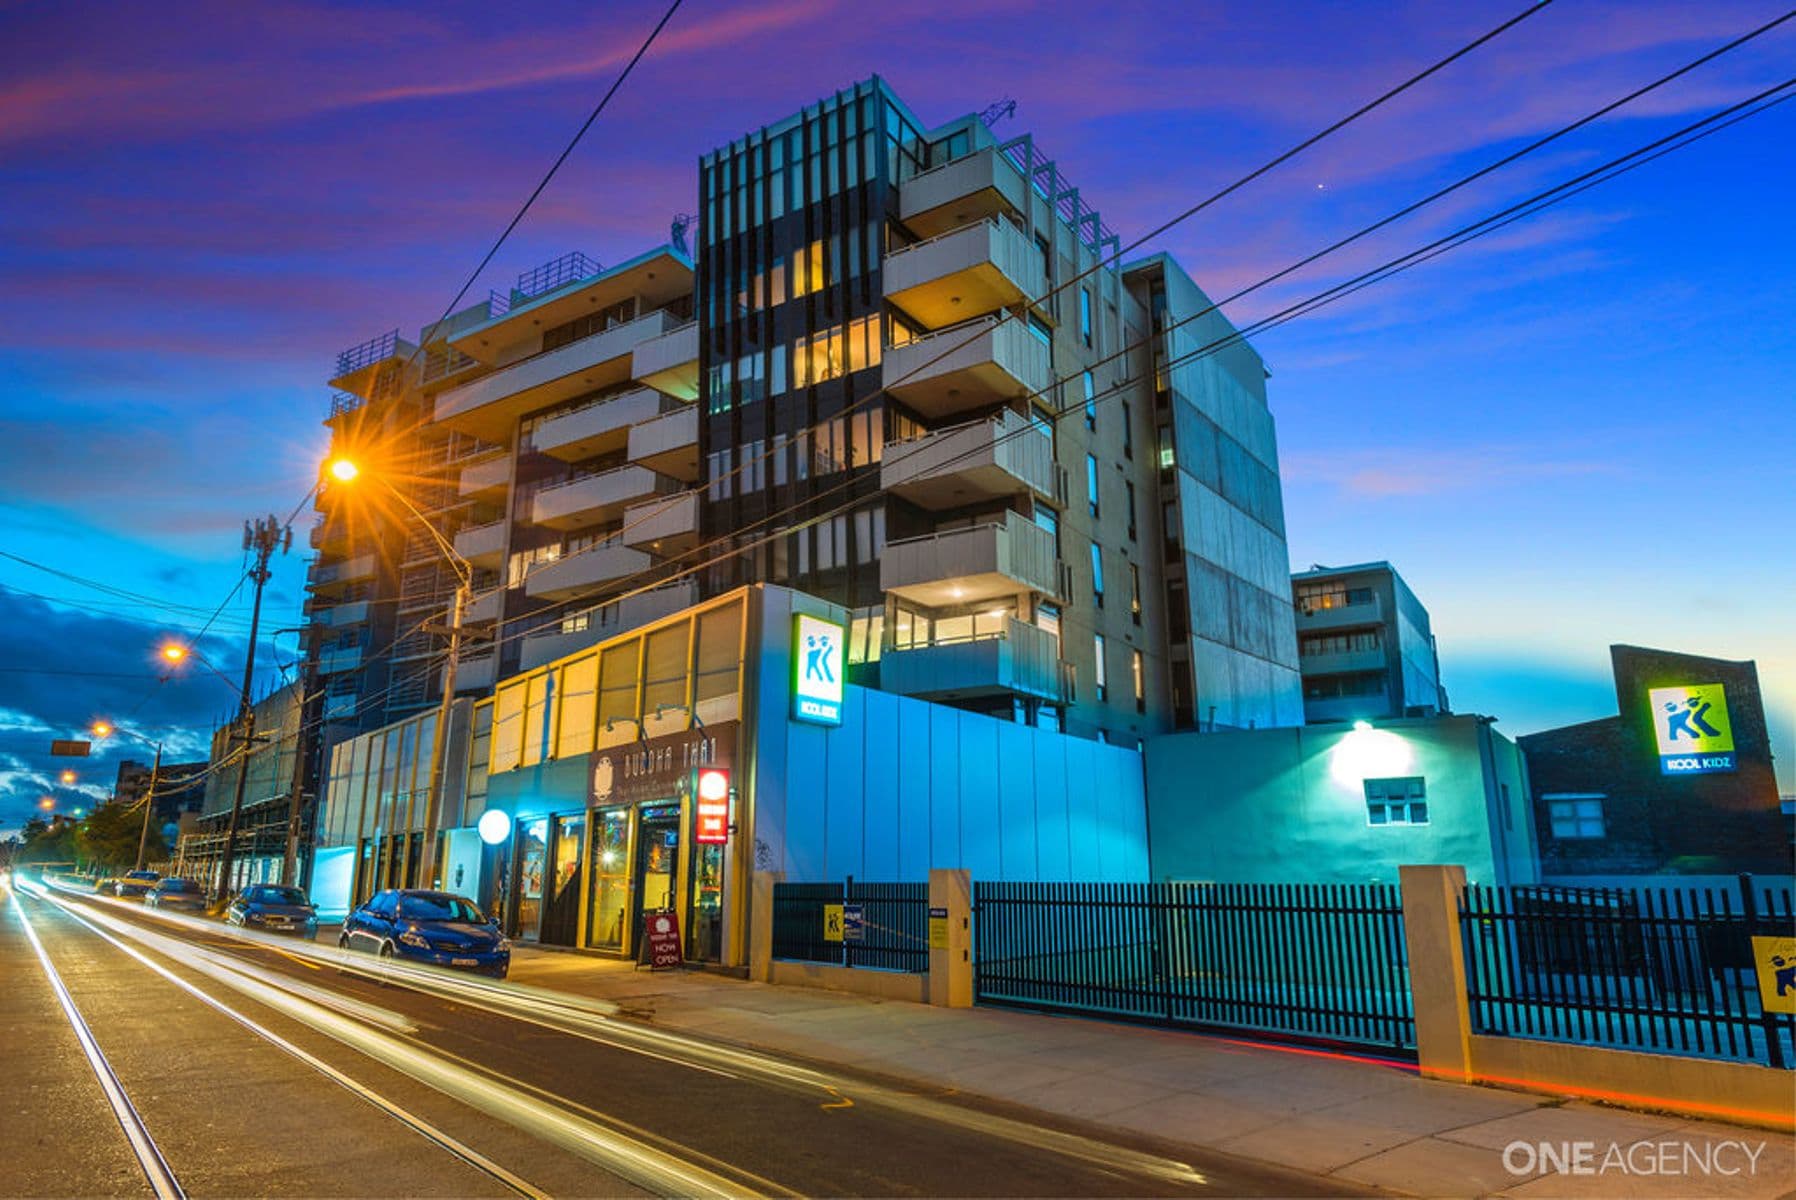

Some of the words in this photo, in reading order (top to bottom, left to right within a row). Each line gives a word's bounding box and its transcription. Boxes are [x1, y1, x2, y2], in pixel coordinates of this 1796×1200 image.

[1667, 758, 1701, 770] KOOL
[1702, 757, 1731, 768] KIDZ
[655, 944, 676, 953] NOW
[655, 954, 679, 965] OPEN
